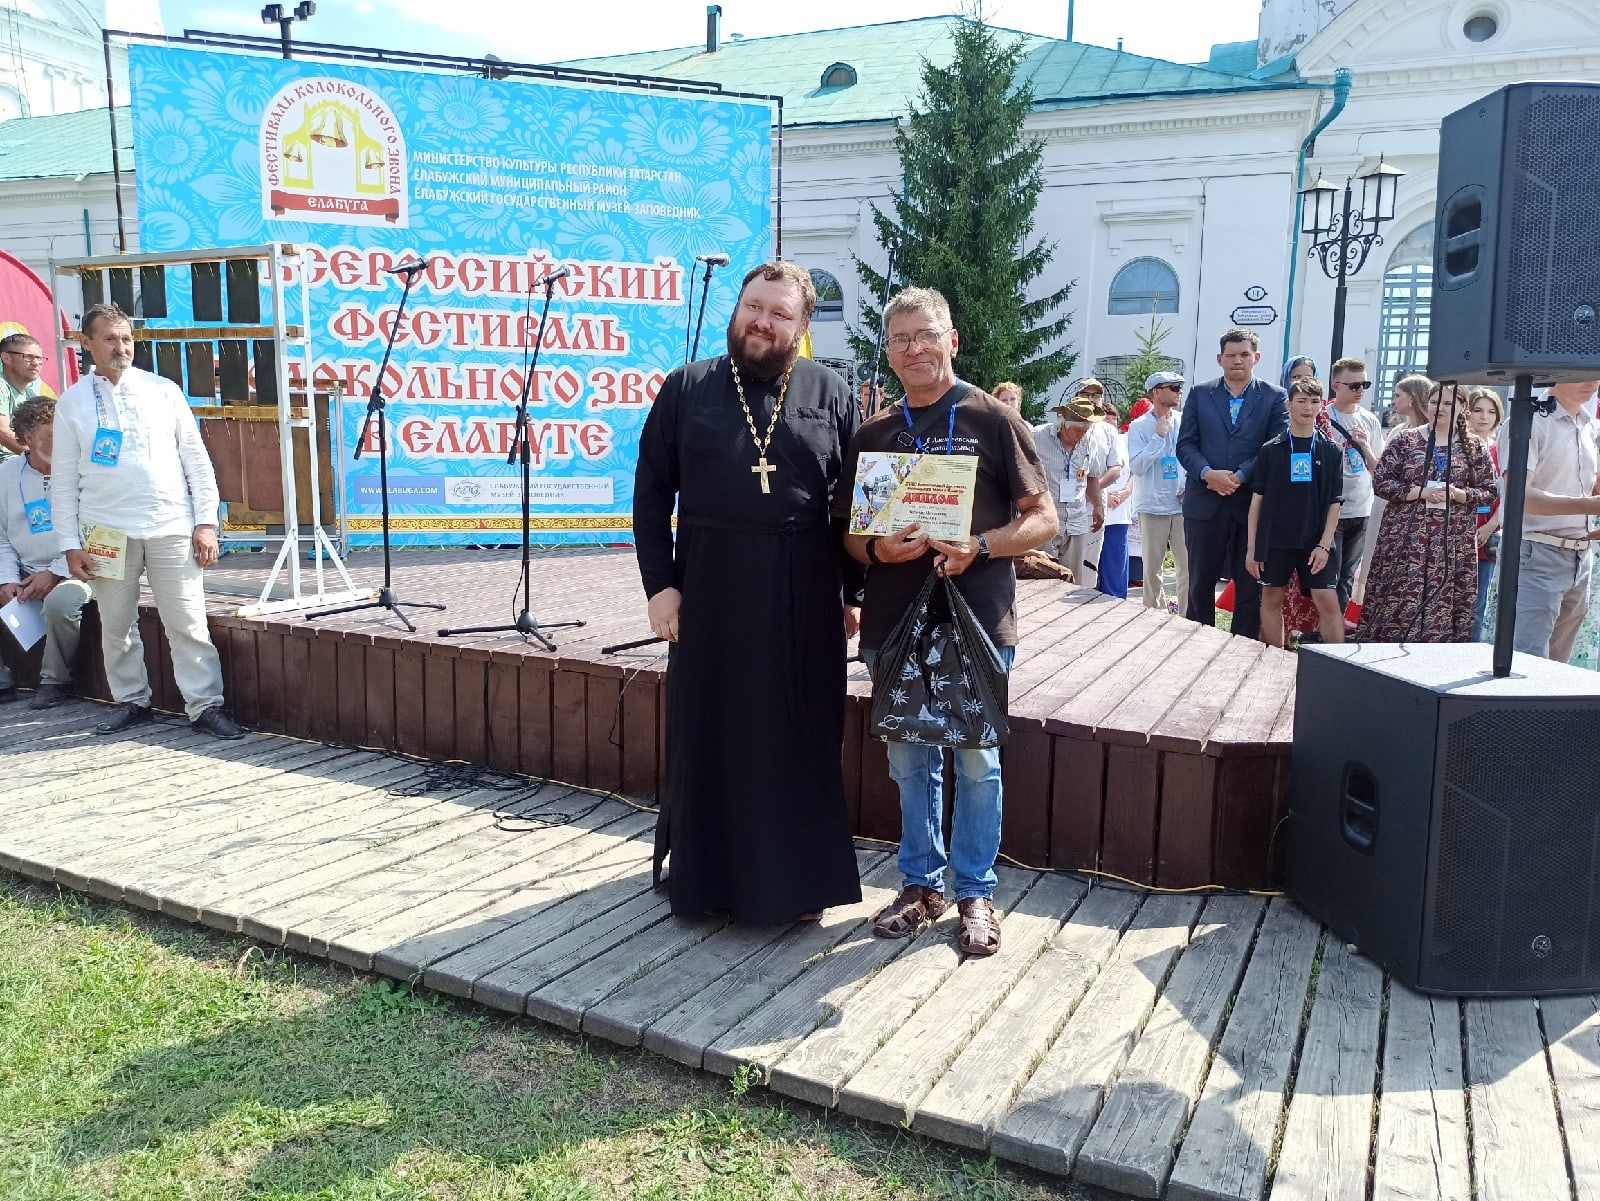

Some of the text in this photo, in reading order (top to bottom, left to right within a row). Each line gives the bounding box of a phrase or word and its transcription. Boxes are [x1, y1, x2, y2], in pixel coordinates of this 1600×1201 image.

[265, 81, 401, 195] ФЕСТИВАЛЬ КОЛОКОЛЬНОГО ЗВОНА
[413, 151, 681, 183] МИНИСТЕРСТВО КУЛЬТУРЫ РЕСПУБЛИКИ ТАТАРСТАН
[414, 169, 627, 196] ЕЛАБУЖСКИЙ МУНИЦИПАЛЬНЫЙ РАЙОН
[307, 197, 369, 213] ЕЛАБУГА
[414, 187, 701, 219] ЕЛАБУЖСКИЙ ГОСУДАРСТВЕННЫЙ МУЗЕЙ-ЗАПОВЕДНИК
[333, 308, 625, 351] ФЕСТИВАЛЬ
[214, 359, 667, 408] ОКОЛЬНОГО ЗВО
[361, 419, 609, 465] В ЕЛАБУГЕ
